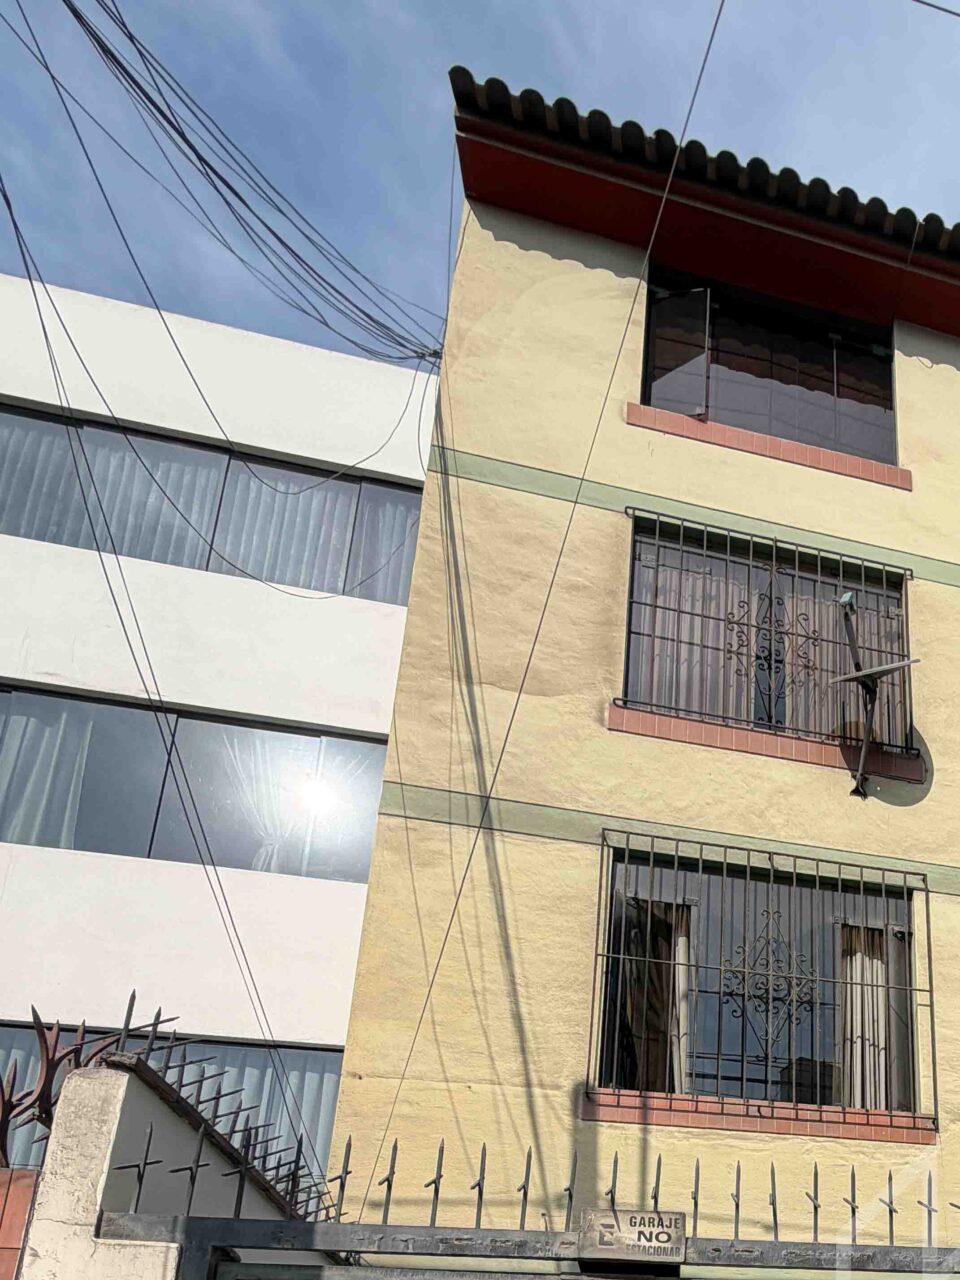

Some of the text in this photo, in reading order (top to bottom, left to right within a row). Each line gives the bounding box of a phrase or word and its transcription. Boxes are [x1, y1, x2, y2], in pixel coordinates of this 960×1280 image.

[629, 1216, 681, 1229] GARAJE
[637, 1230, 672, 1244] NO
[625, 1244, 681, 1258] ESTACIONAR
